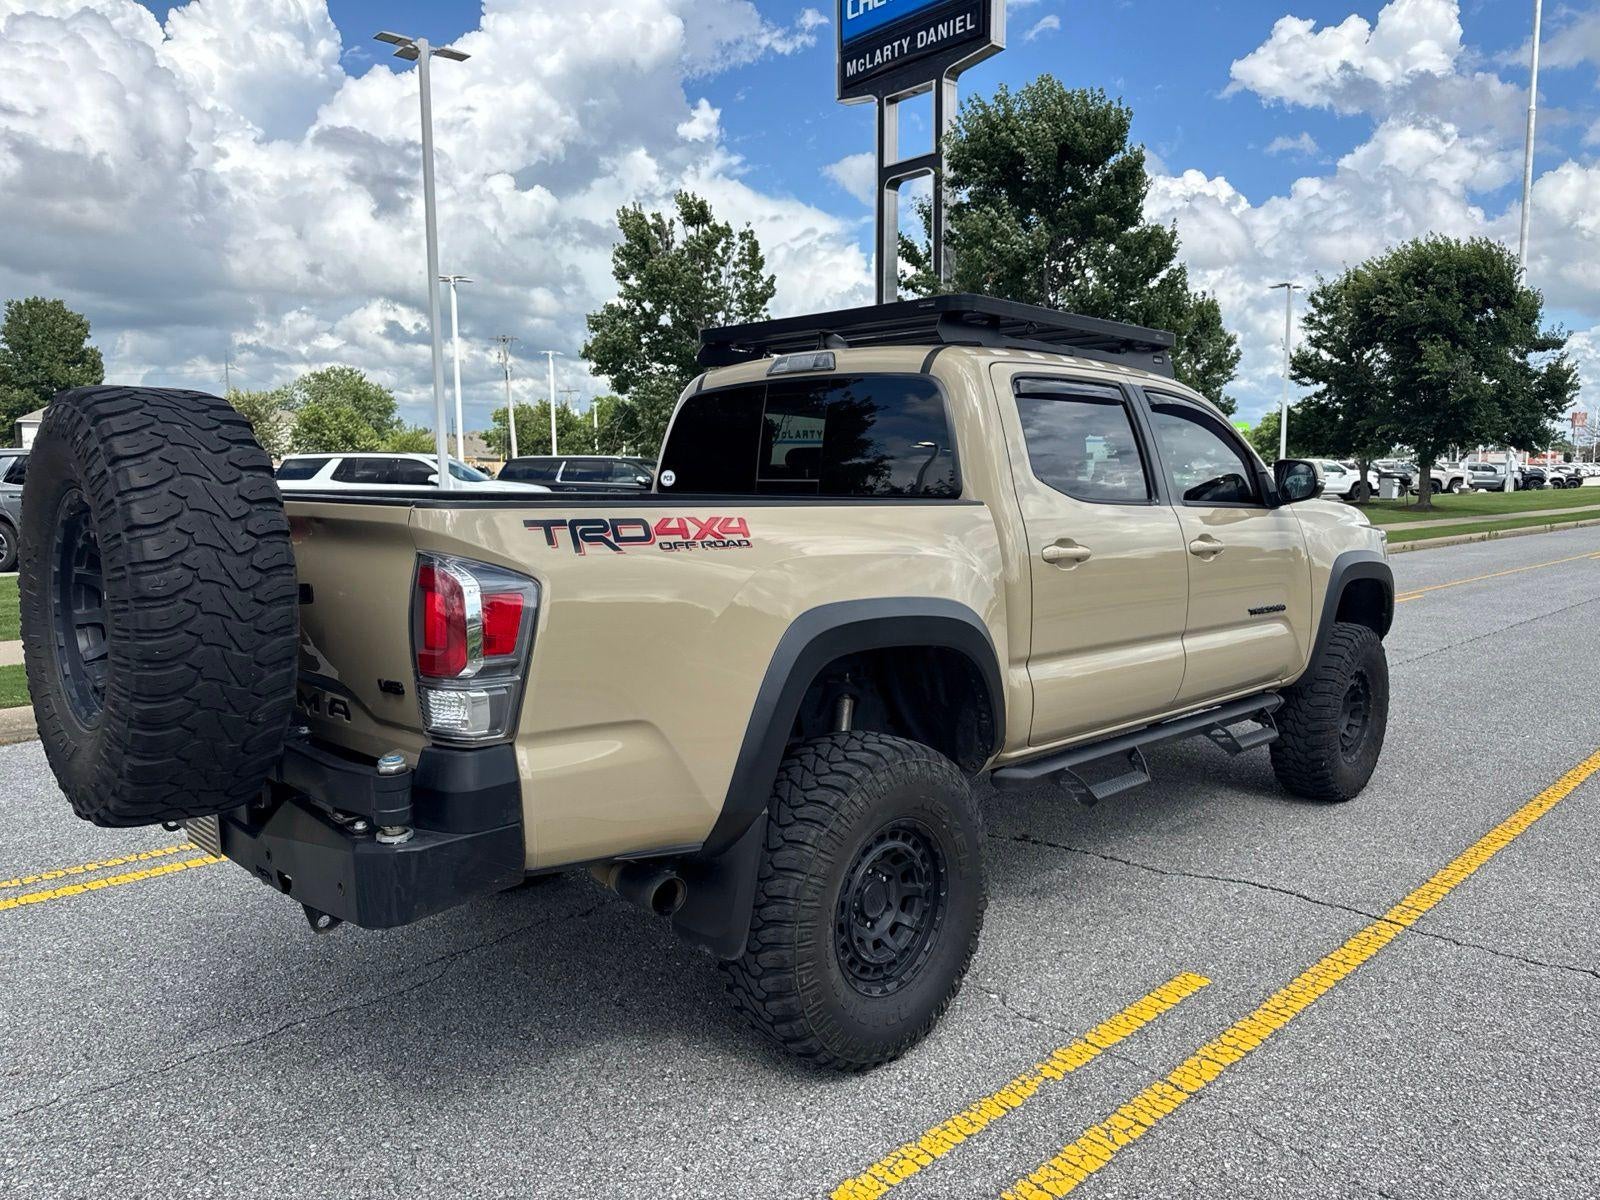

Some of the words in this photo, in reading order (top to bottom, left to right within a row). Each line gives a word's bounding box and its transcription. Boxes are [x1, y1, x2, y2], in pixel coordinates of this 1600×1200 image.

[846, 36, 911, 77] McLARTY
[917, 13, 976, 49] DANIEL
[522, 517, 654, 556] TRD
[658, 540, 698, 551] OFF
[700, 539, 752, 550] ROAD
